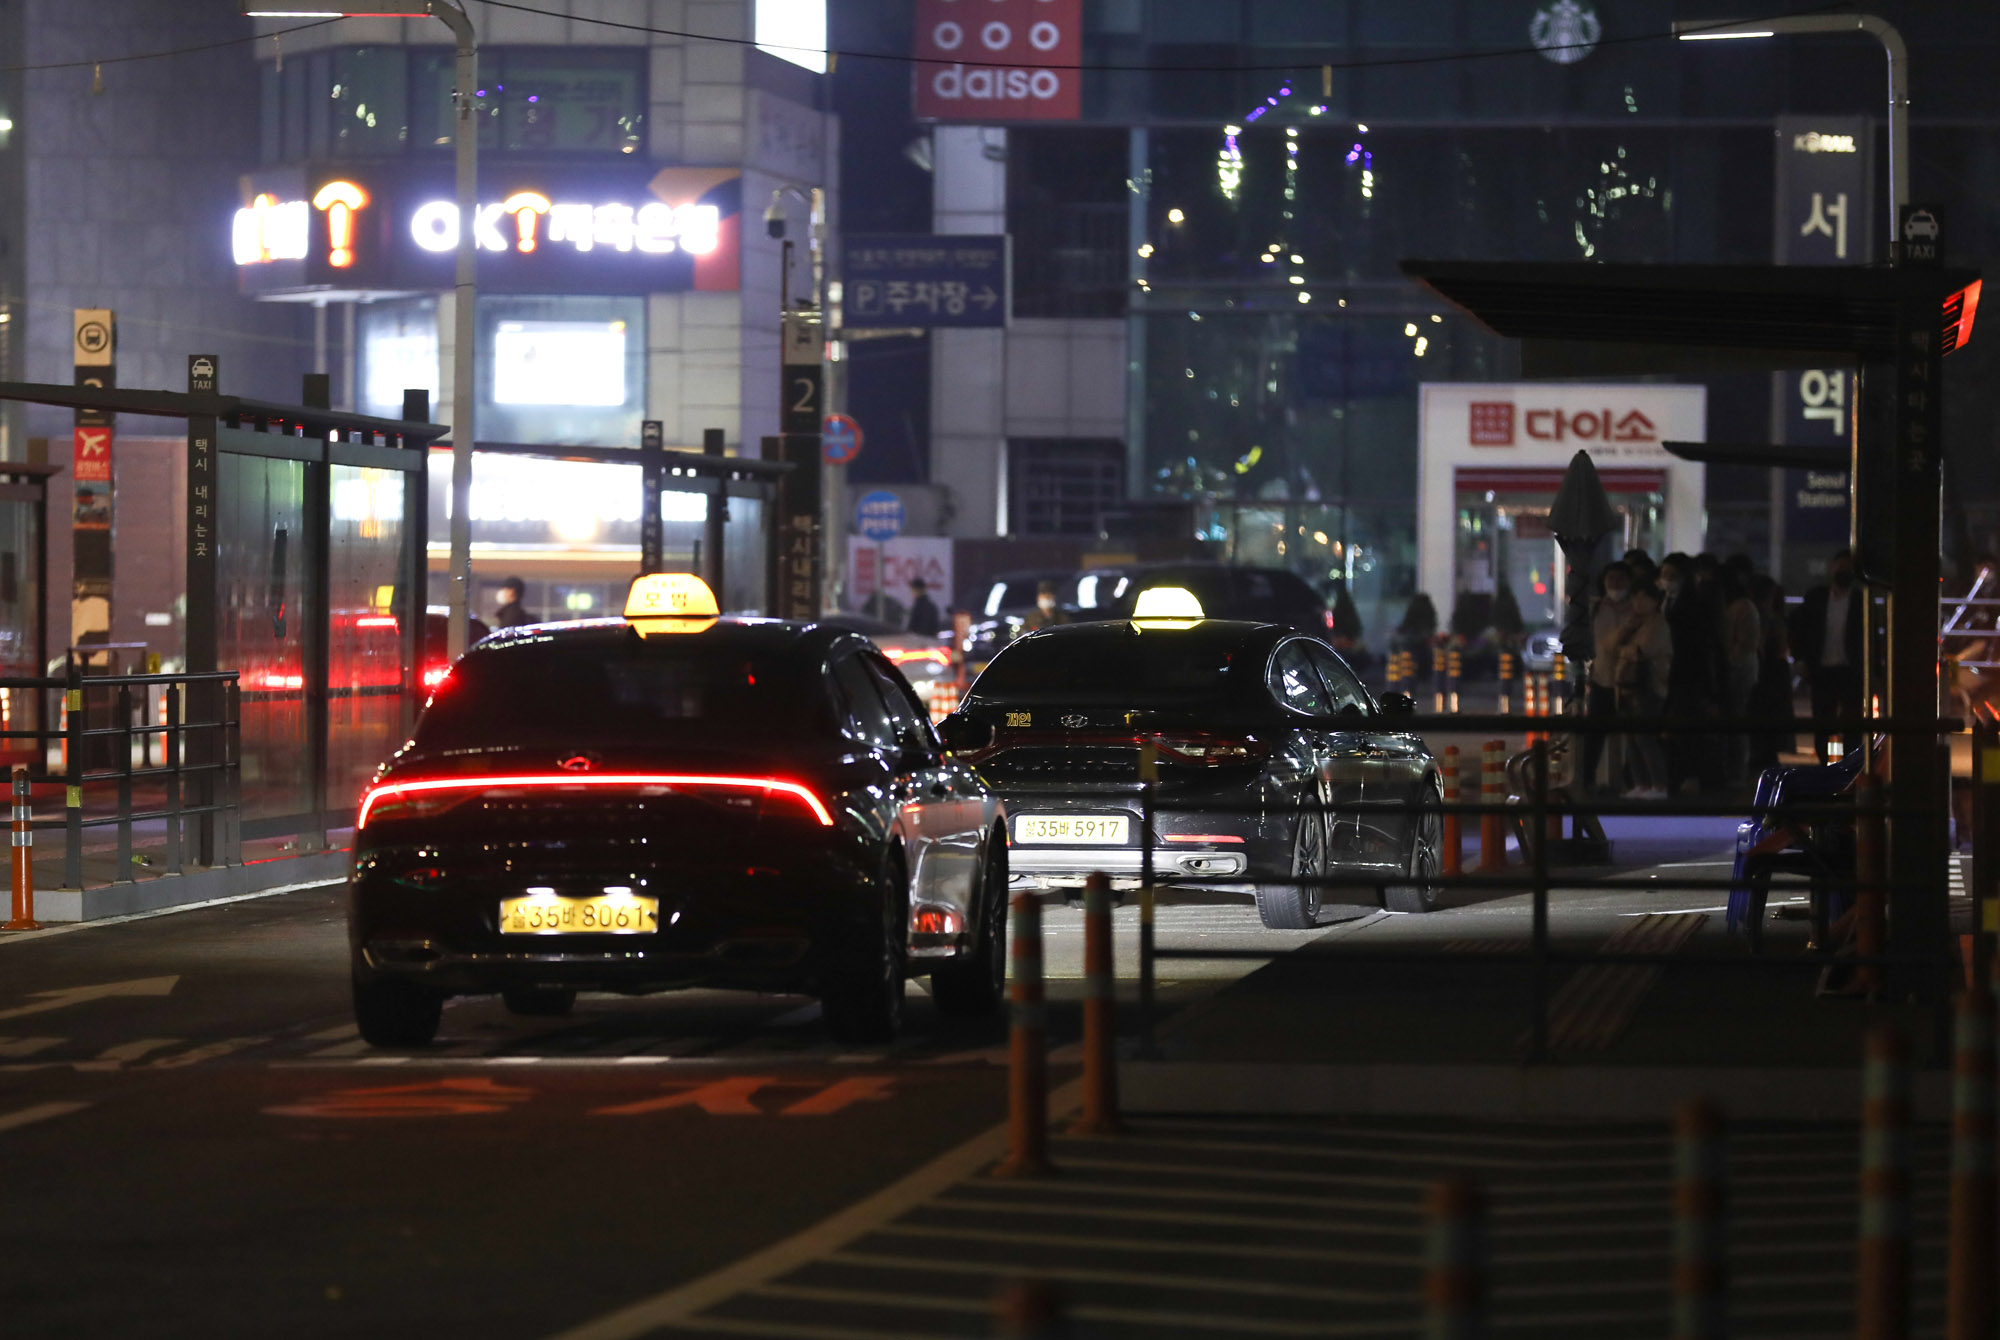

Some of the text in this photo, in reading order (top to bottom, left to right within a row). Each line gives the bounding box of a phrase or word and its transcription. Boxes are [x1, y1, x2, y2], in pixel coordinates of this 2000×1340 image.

[932, 60, 1060, 100] daiso
[410, 200, 508, 253] OK
[1906, 244, 1935, 259] TAXI
[887, 280, 969, 316] 주차장
[193, 379, 212, 390] TAXI
[791, 377, 815, 413] 2
[1525, 408, 1657, 443] 다이소
[1807, 470, 1846, 490] Seoul
[194, 438, 208, 557] 택시 내리는곳
[1005, 712, 1032, 727] 개인
[1074, 820, 1119, 838] 5917
[582, 903, 643, 928] 8061
